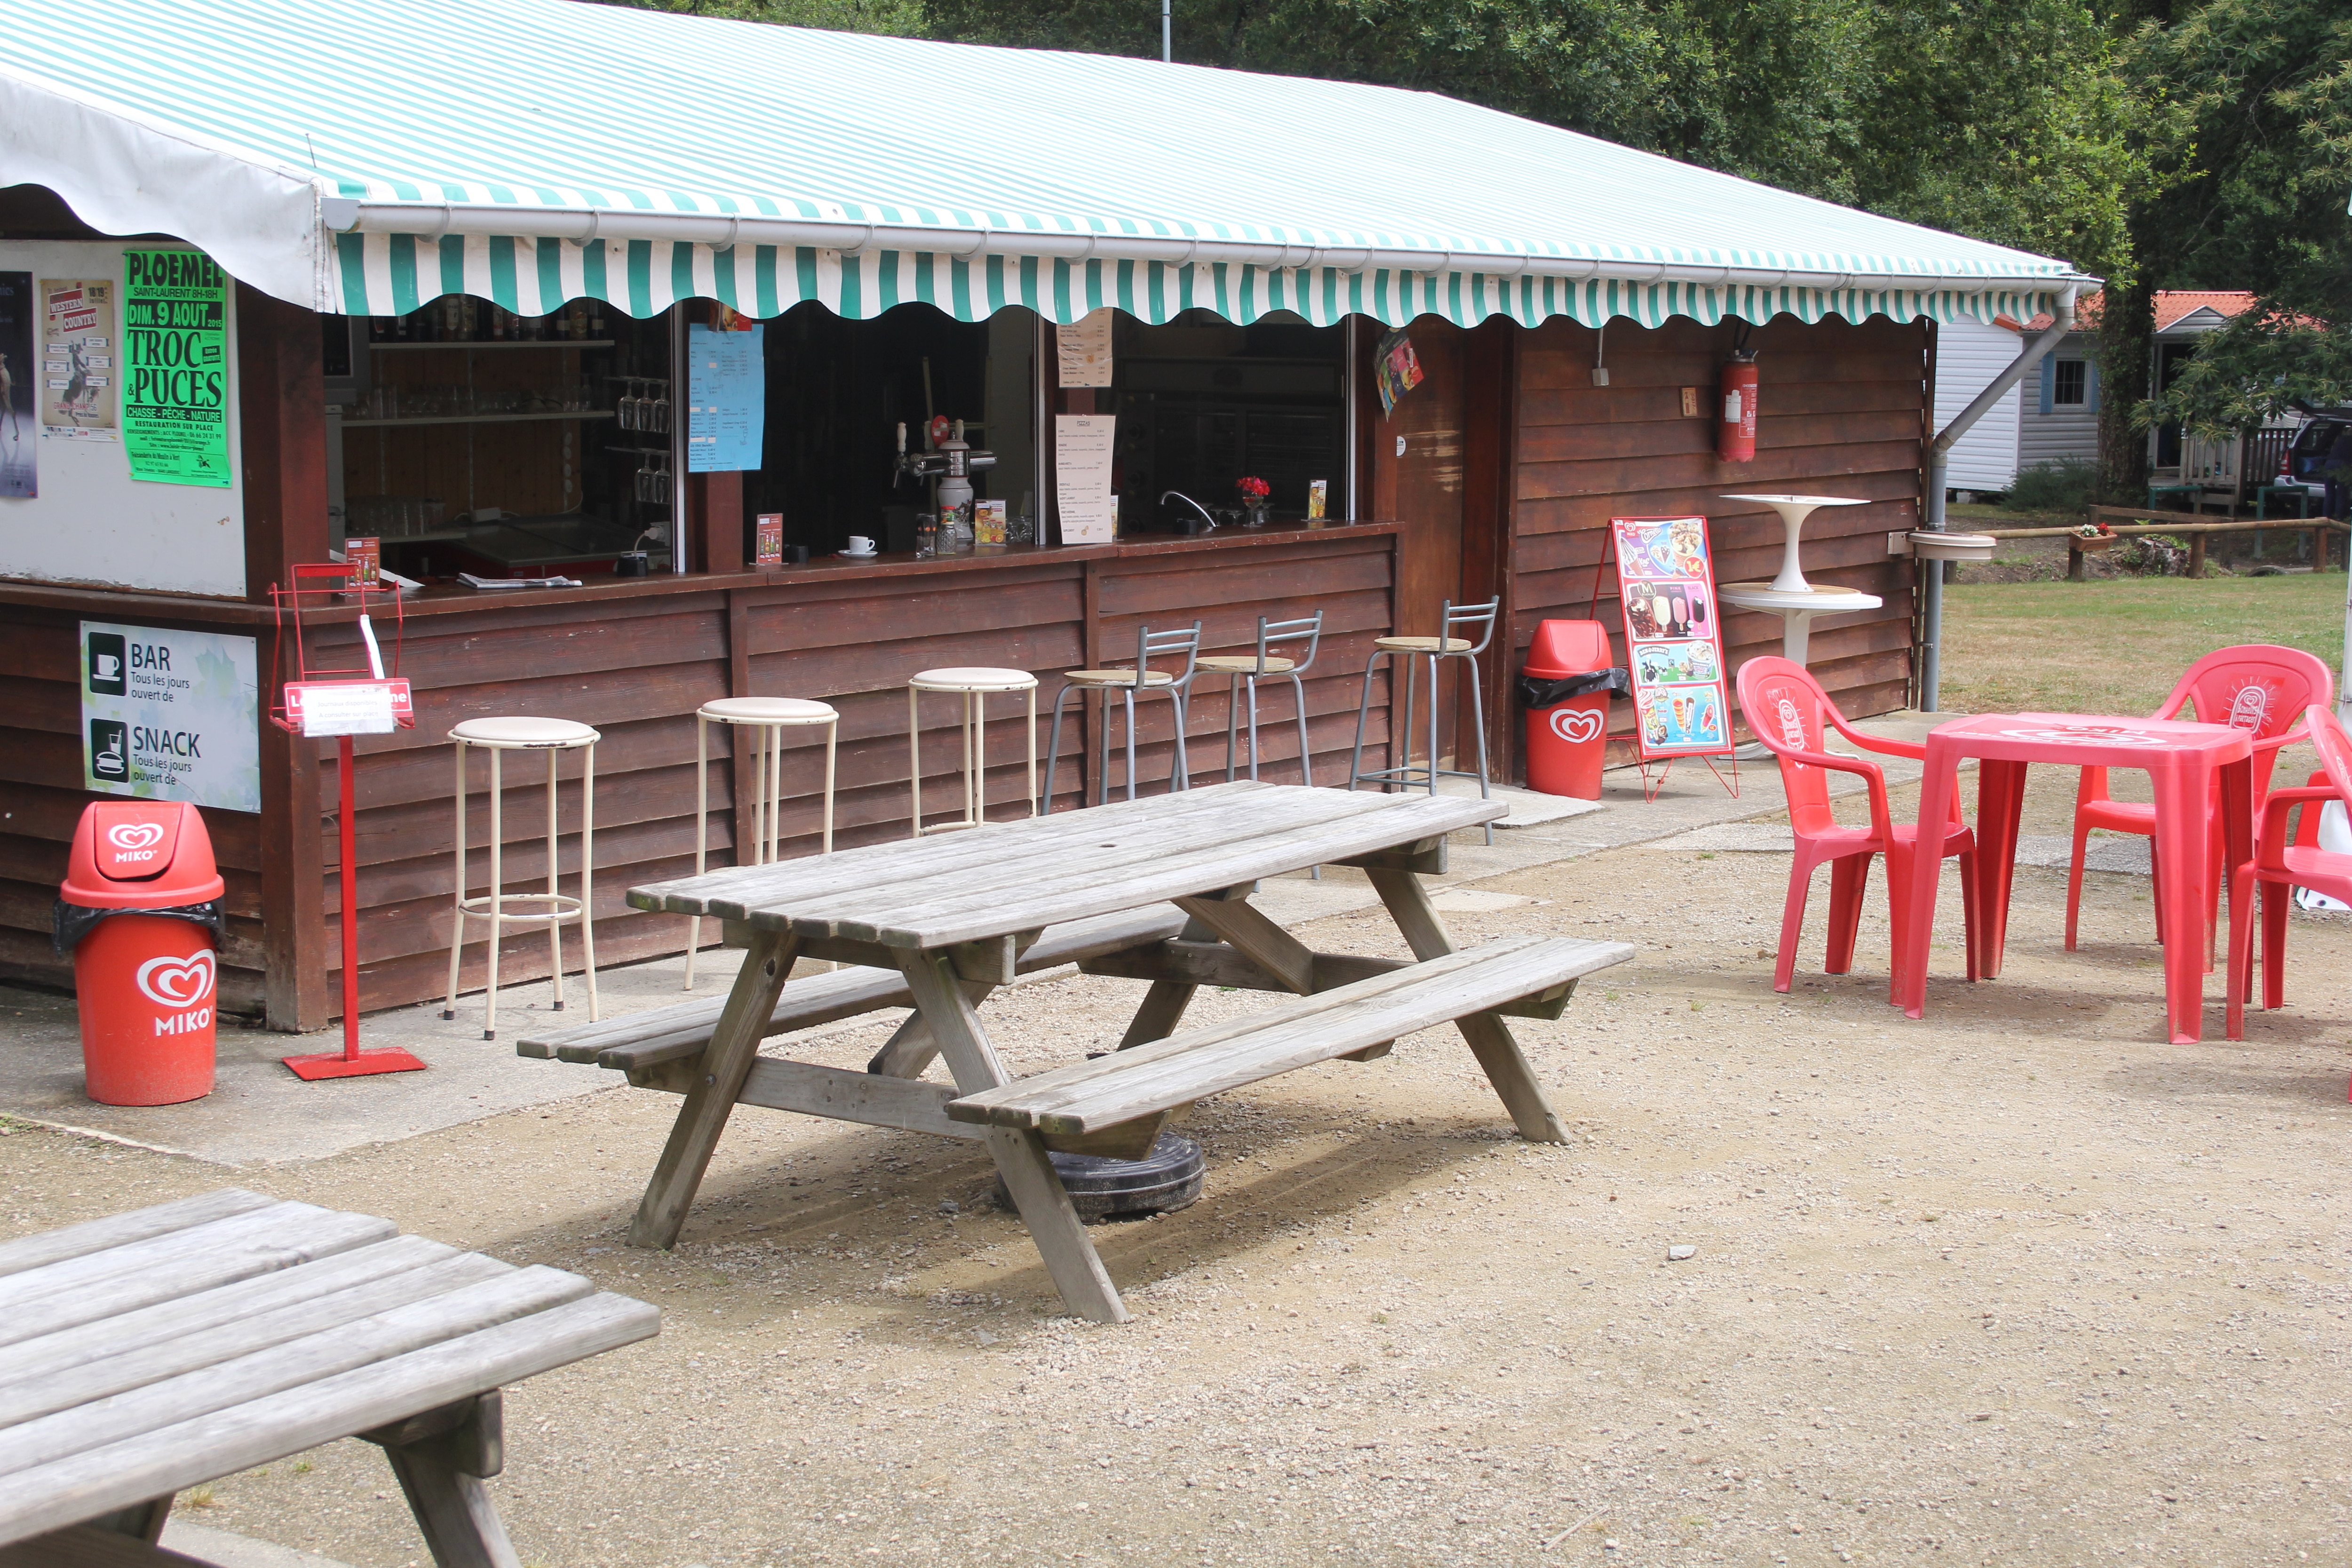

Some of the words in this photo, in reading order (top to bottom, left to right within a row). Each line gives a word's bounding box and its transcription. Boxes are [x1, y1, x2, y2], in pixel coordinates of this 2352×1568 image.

[129, 253, 223, 288] PLOEMEL
[134, 287, 191, 297] SAINT-LAURENT
[192, 289, 218, 299] 8H-18H
[50, 298, 83, 312] WESTERN
[64, 313, 96, 329] COUNTRY
[129, 305, 155, 325] DIM.
[157, 302, 169, 326] 9
[173, 302, 209, 327] AOUT
[207, 319, 222, 327] 2015
[128, 329, 201, 368] TROC
[127, 383, 135, 396] &
[134, 368, 222, 408] PUCES
[127, 407, 156, 418] CHASSE
[162, 407, 186, 420] PÊCHE
[191, 411, 221, 422] NATURE
[1637, 526, 1663, 544] Cornetto
[131, 644, 171, 671] BAR
[131, 671, 151, 685] Tous
[153, 673, 166, 686] les
[167, 674, 190, 689] jours
[131, 689, 160, 701] ouvert
[162, 690, 174, 702] de
[2066, 726, 2146, 735] MIKO
[134, 726, 202, 758] SNACK
[133, 754, 154, 767] Tous
[155, 756, 167, 768] les
[168, 758, 192, 772] jours
[134, 771, 163, 783] ouvert
[165, 773, 176, 785] de
[116, 850, 153, 863] MIKO
[156, 1008, 210, 1036] MIKO
